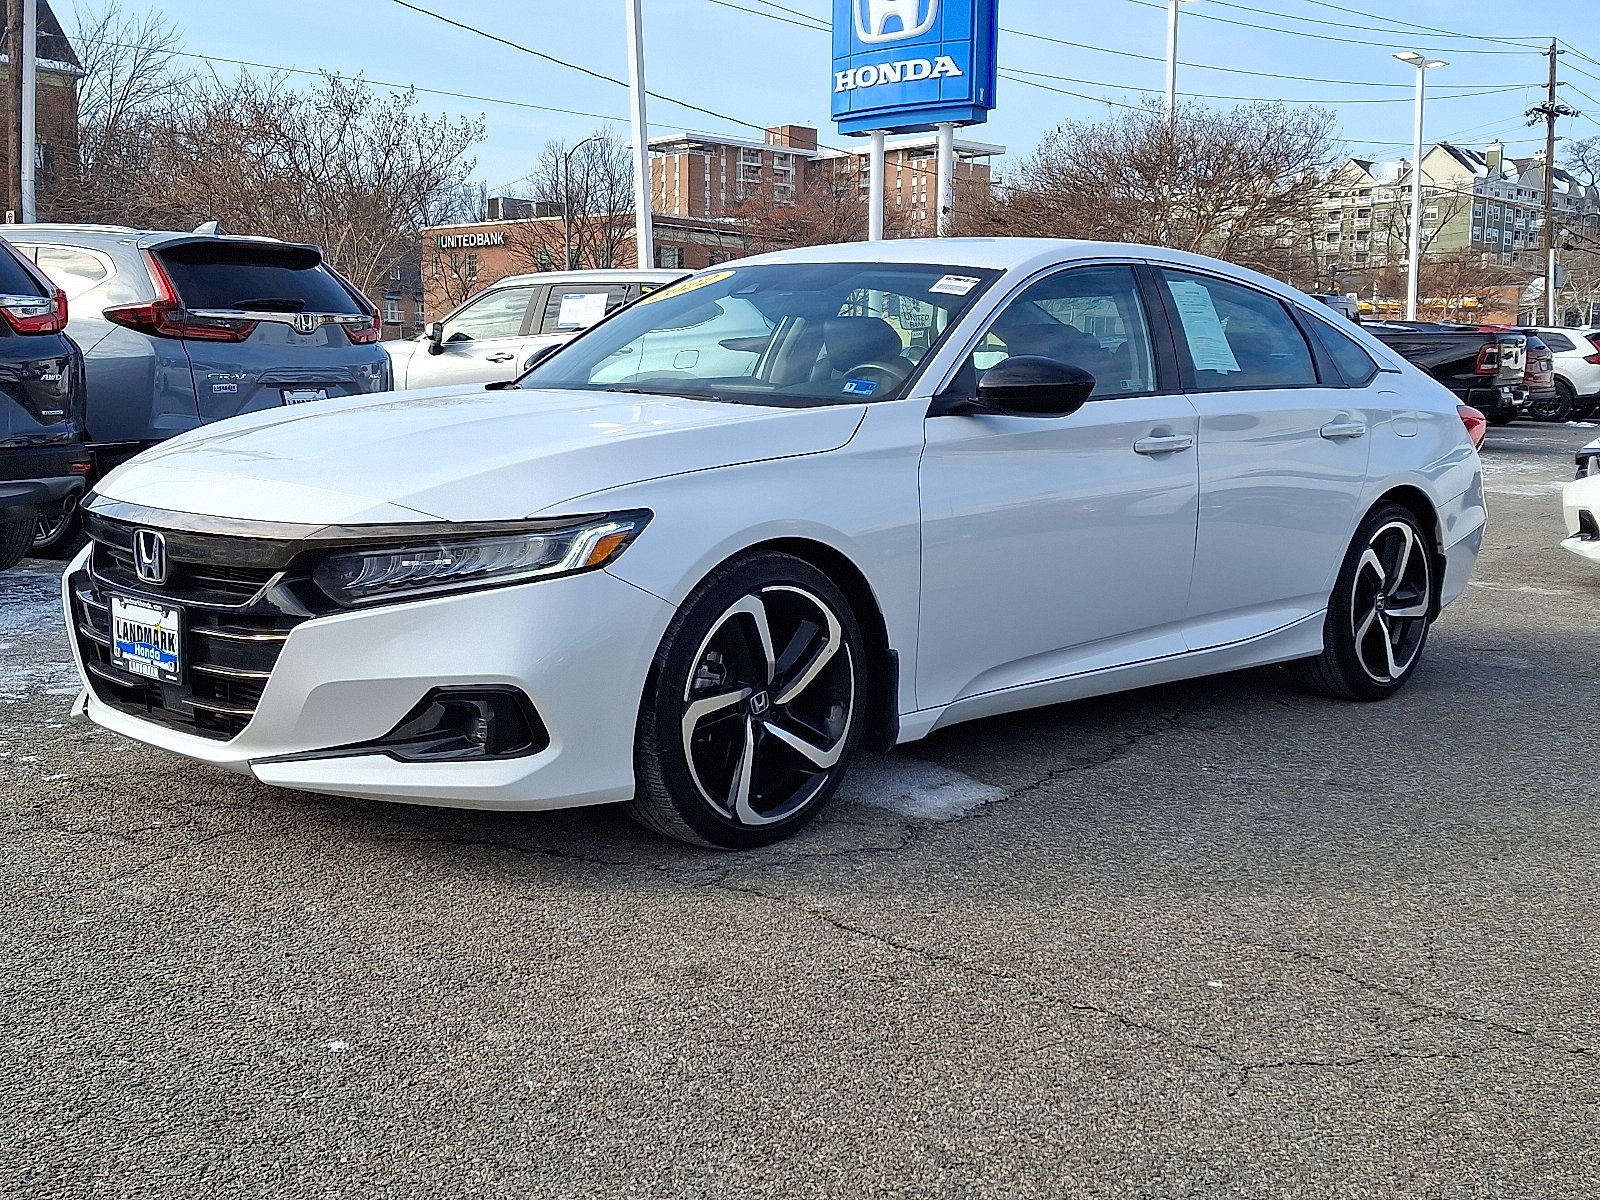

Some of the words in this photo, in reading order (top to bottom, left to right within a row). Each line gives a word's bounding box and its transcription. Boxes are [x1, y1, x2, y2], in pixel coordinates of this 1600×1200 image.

[834, 55, 963, 93] HONDA
[903, 311, 929, 321] UNITED
[116, 620, 176, 653] LANDMARK
[134, 642, 161, 661] Honda
